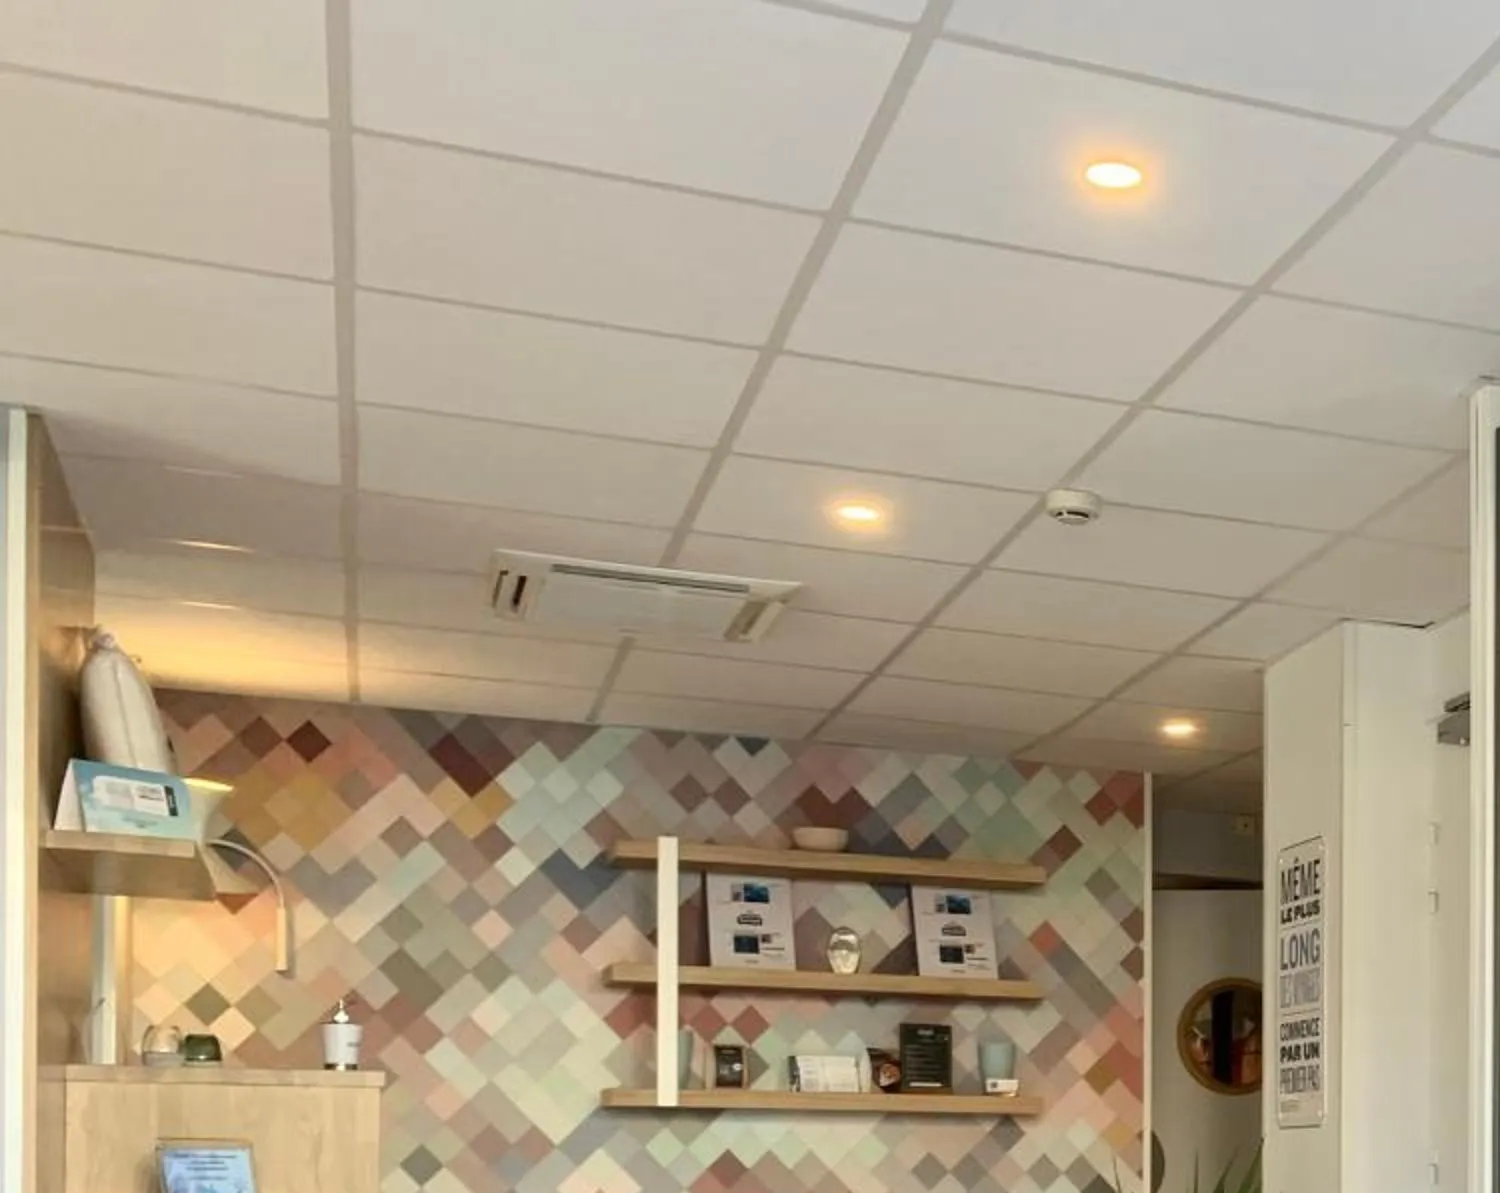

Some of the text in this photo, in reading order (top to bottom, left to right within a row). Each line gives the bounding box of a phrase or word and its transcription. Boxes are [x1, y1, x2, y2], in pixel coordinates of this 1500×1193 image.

[1280, 856, 1320, 905] MÊME
[1280, 899, 1320, 925] LE PLUS
[1280, 928, 1320, 970] LONG
[1280, 1017, 1320, 1041] COMMENCE
[1280, 1041, 1320, 1064] PAR UN
